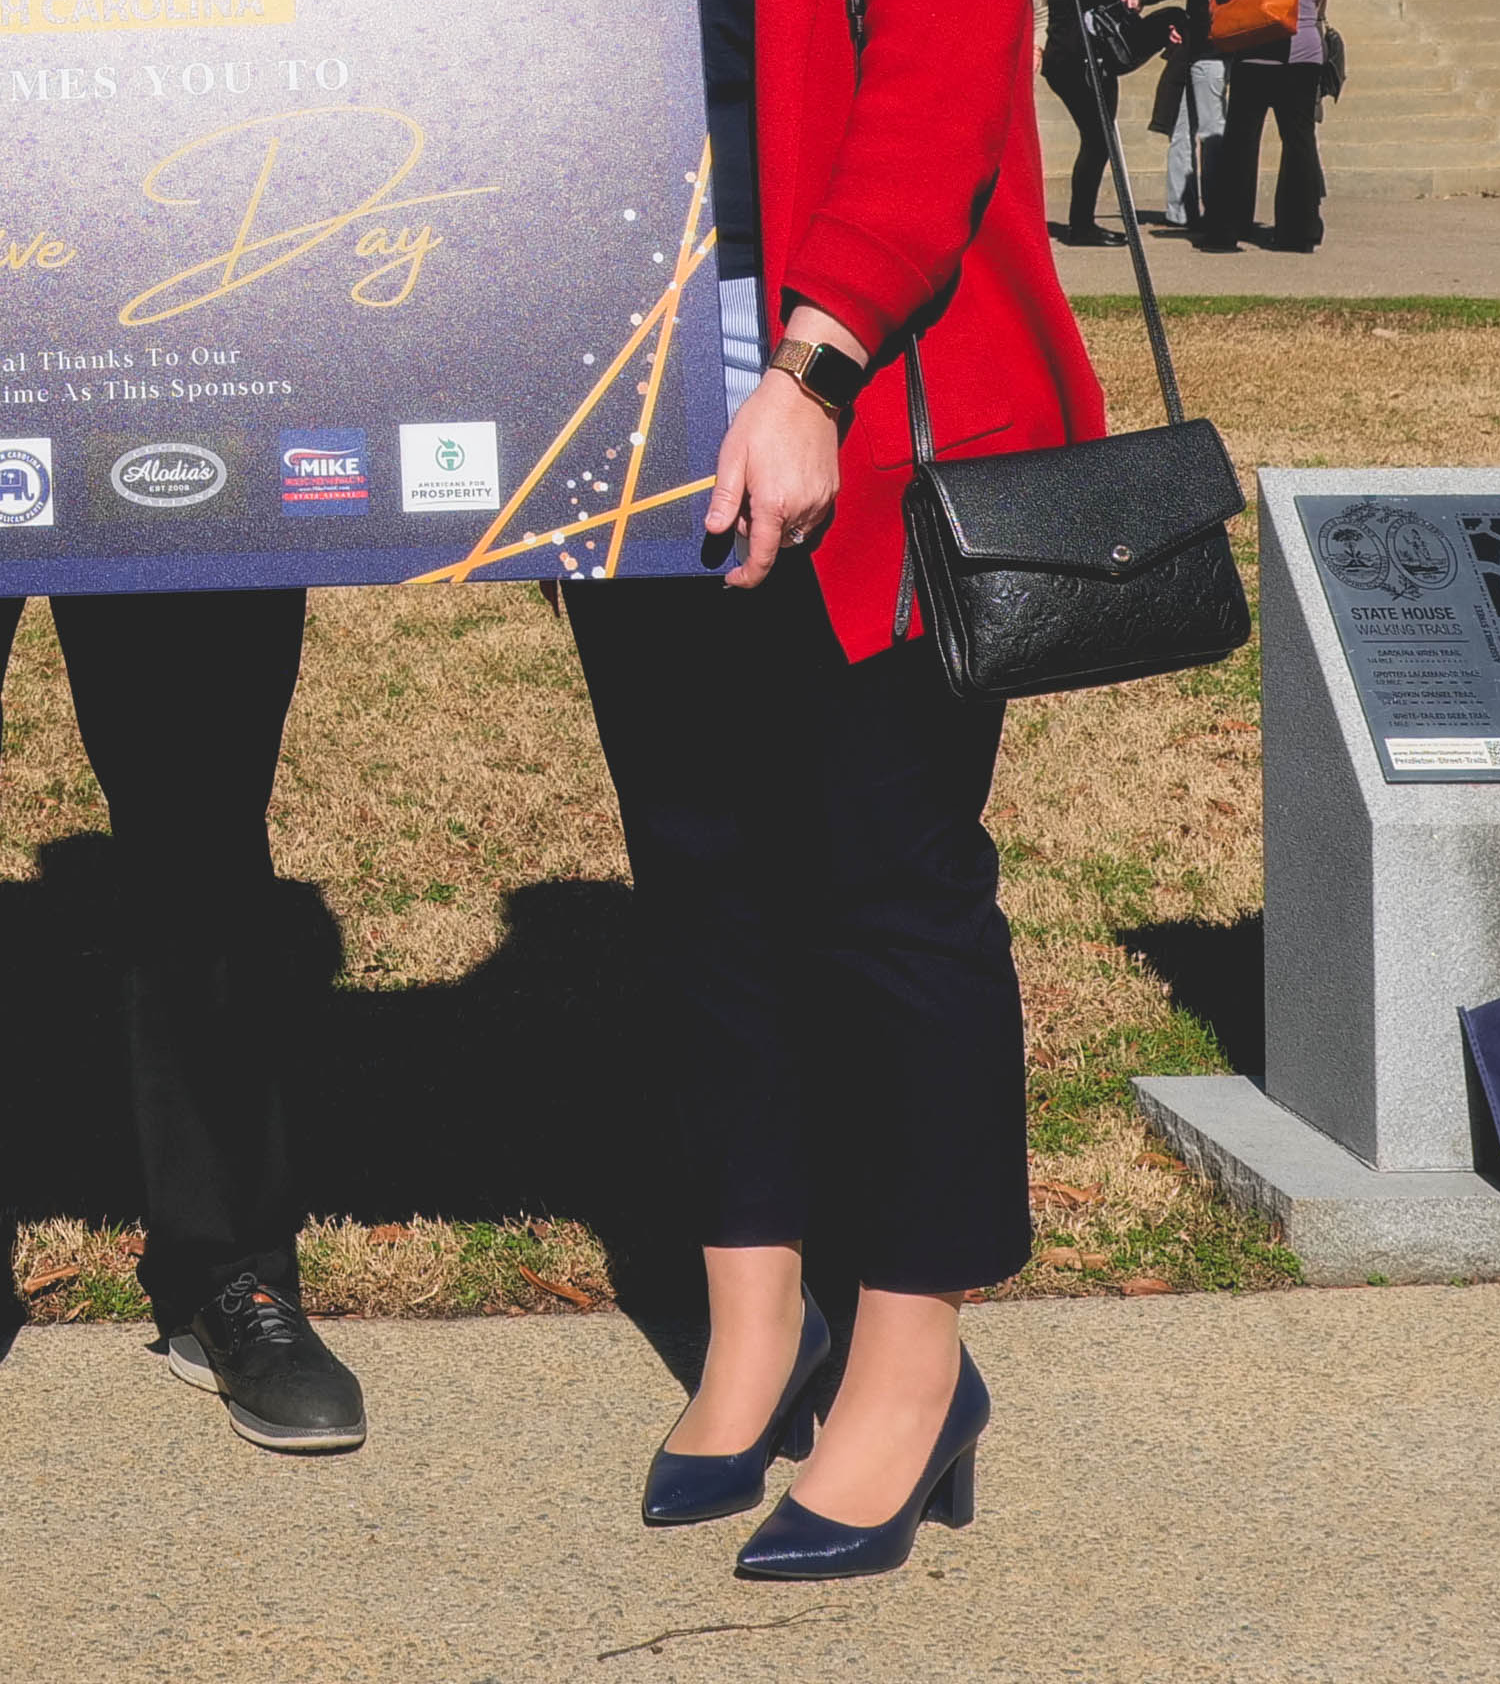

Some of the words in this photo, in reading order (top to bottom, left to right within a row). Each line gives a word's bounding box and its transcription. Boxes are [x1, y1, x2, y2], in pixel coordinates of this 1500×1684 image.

[142, 61, 252, 97] YOU
[278, 58, 350, 91] TO
[117, 105, 500, 327] Day
[37, 349, 135, 372] Thanks
[145, 347, 180, 367] To
[191, 346, 242, 366] Our
[63, 382, 92, 402] As
[103, 380, 160, 401] This
[170, 376, 292, 403] Sponsors
[122, 459, 215, 483] Alodia's
[300, 457, 360, 477] MIKE
[148, 484, 166, 493] EST
[168, 484, 190, 492] 2008
[410, 487, 492, 499] PROSPERITY
[418, 480, 465, 488] AMERICANS
[1350, 607, 1399, 621] STATE
[1399, 607, 1457, 620] HOUSE
[1354, 623, 1416, 636] WALKING
[1418, 623, 1463, 636] TRAILS
